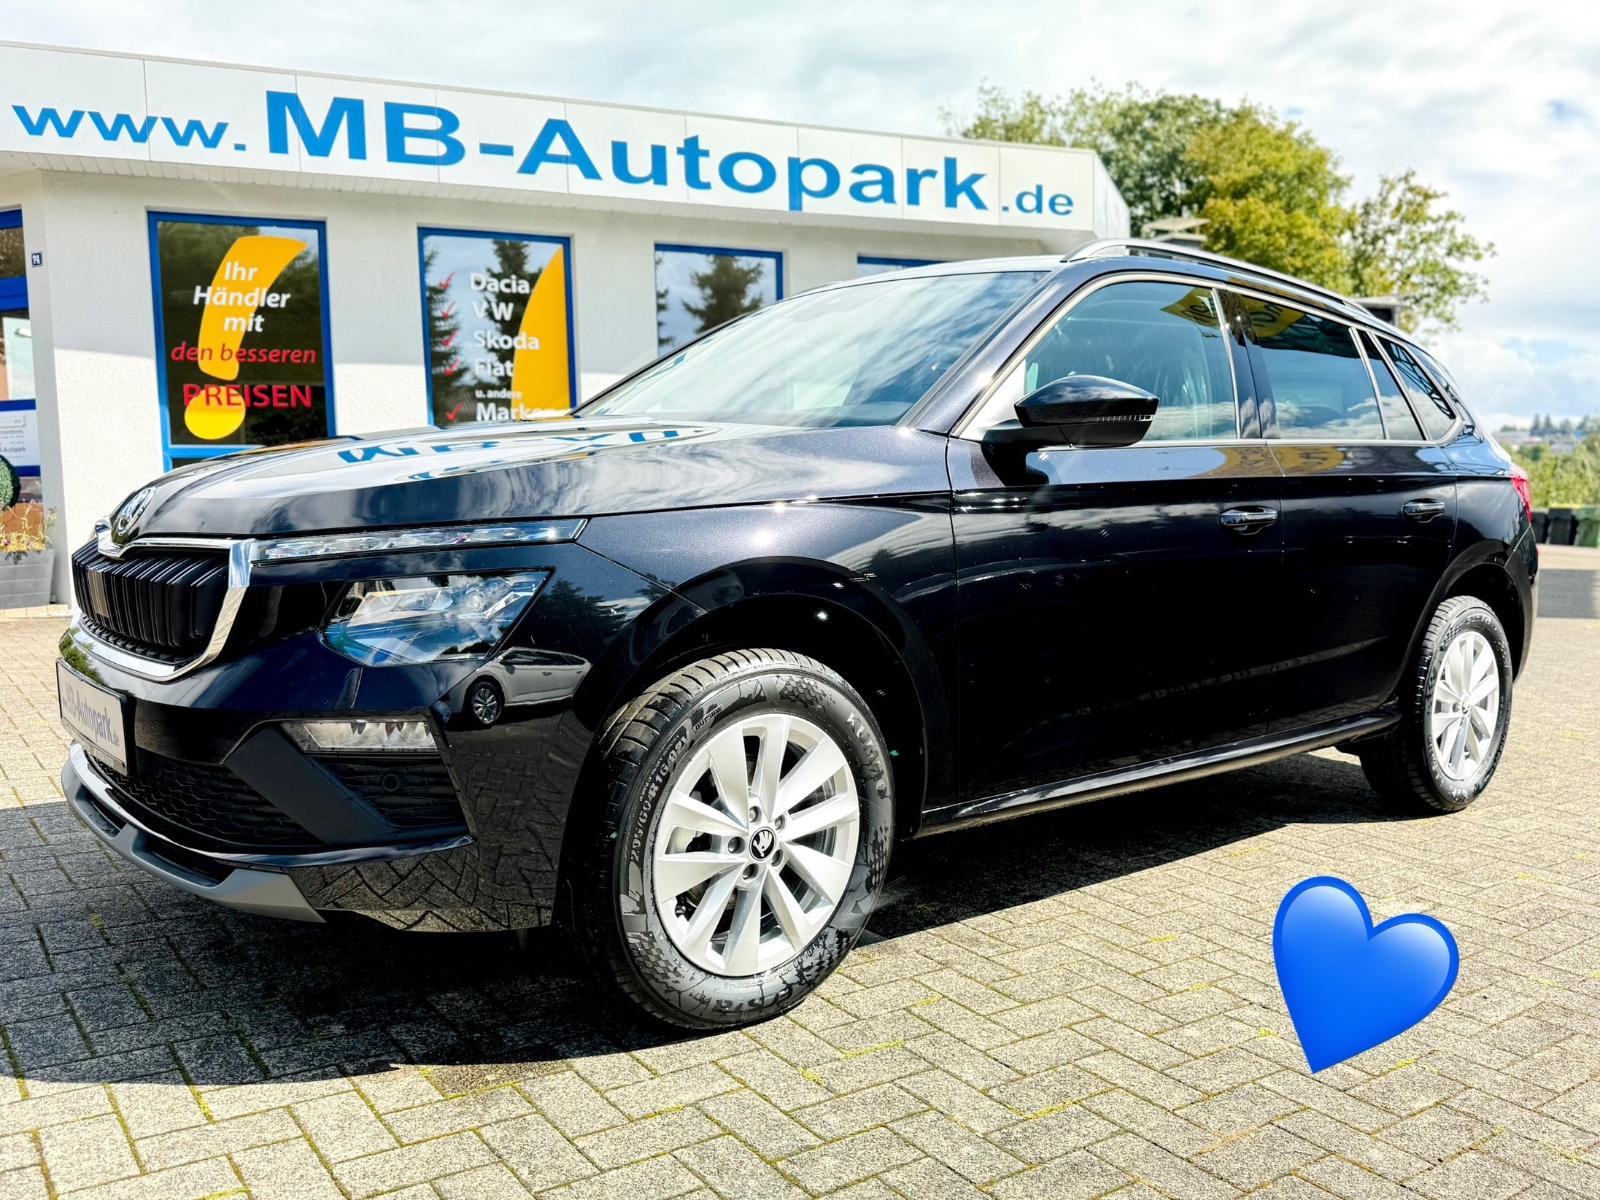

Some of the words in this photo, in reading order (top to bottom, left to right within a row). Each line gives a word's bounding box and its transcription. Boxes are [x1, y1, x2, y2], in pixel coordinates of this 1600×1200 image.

[224, 261, 258, 281] Ihr
[470, 273, 530, 294] Dacia
[193, 285, 291, 308] Händler
[224, 314, 265, 333] mit
[473, 330, 540, 350] Skoda
[171, 341, 213, 361] den
[220, 343, 317, 364] besseren
[474, 359, 514, 377] Fiat
[183, 384, 313, 408] PREISEN
